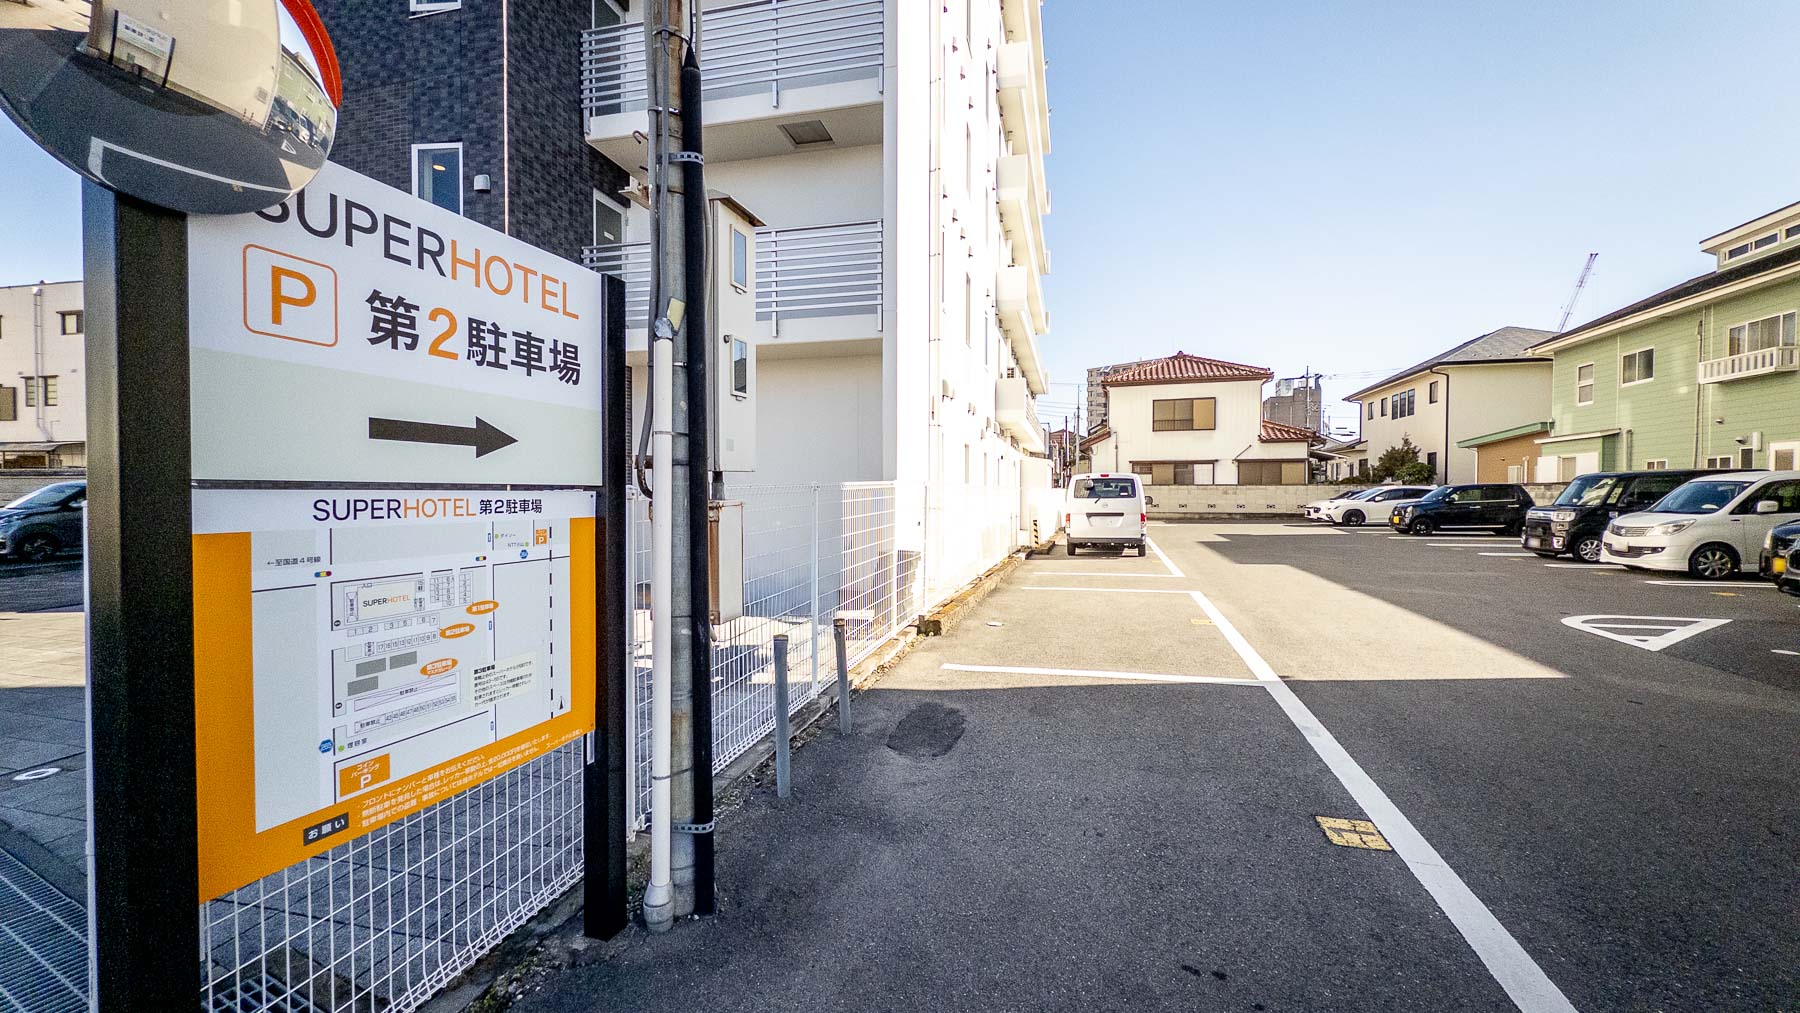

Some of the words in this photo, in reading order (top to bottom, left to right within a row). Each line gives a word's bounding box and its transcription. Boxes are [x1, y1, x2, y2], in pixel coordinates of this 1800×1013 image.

[270, 264, 317, 325] P
[364, 288, 582, 386] 第2駐車場
[312, 498, 477, 522] SUPERHOTEL
[479, 499, 543, 515] 第2駐車場
[362, 594, 411, 608] SUPERHOTEL
[357, 760, 374, 771] コイン
[360, 774, 372, 788] P
[308, 819, 345, 840] お願い
